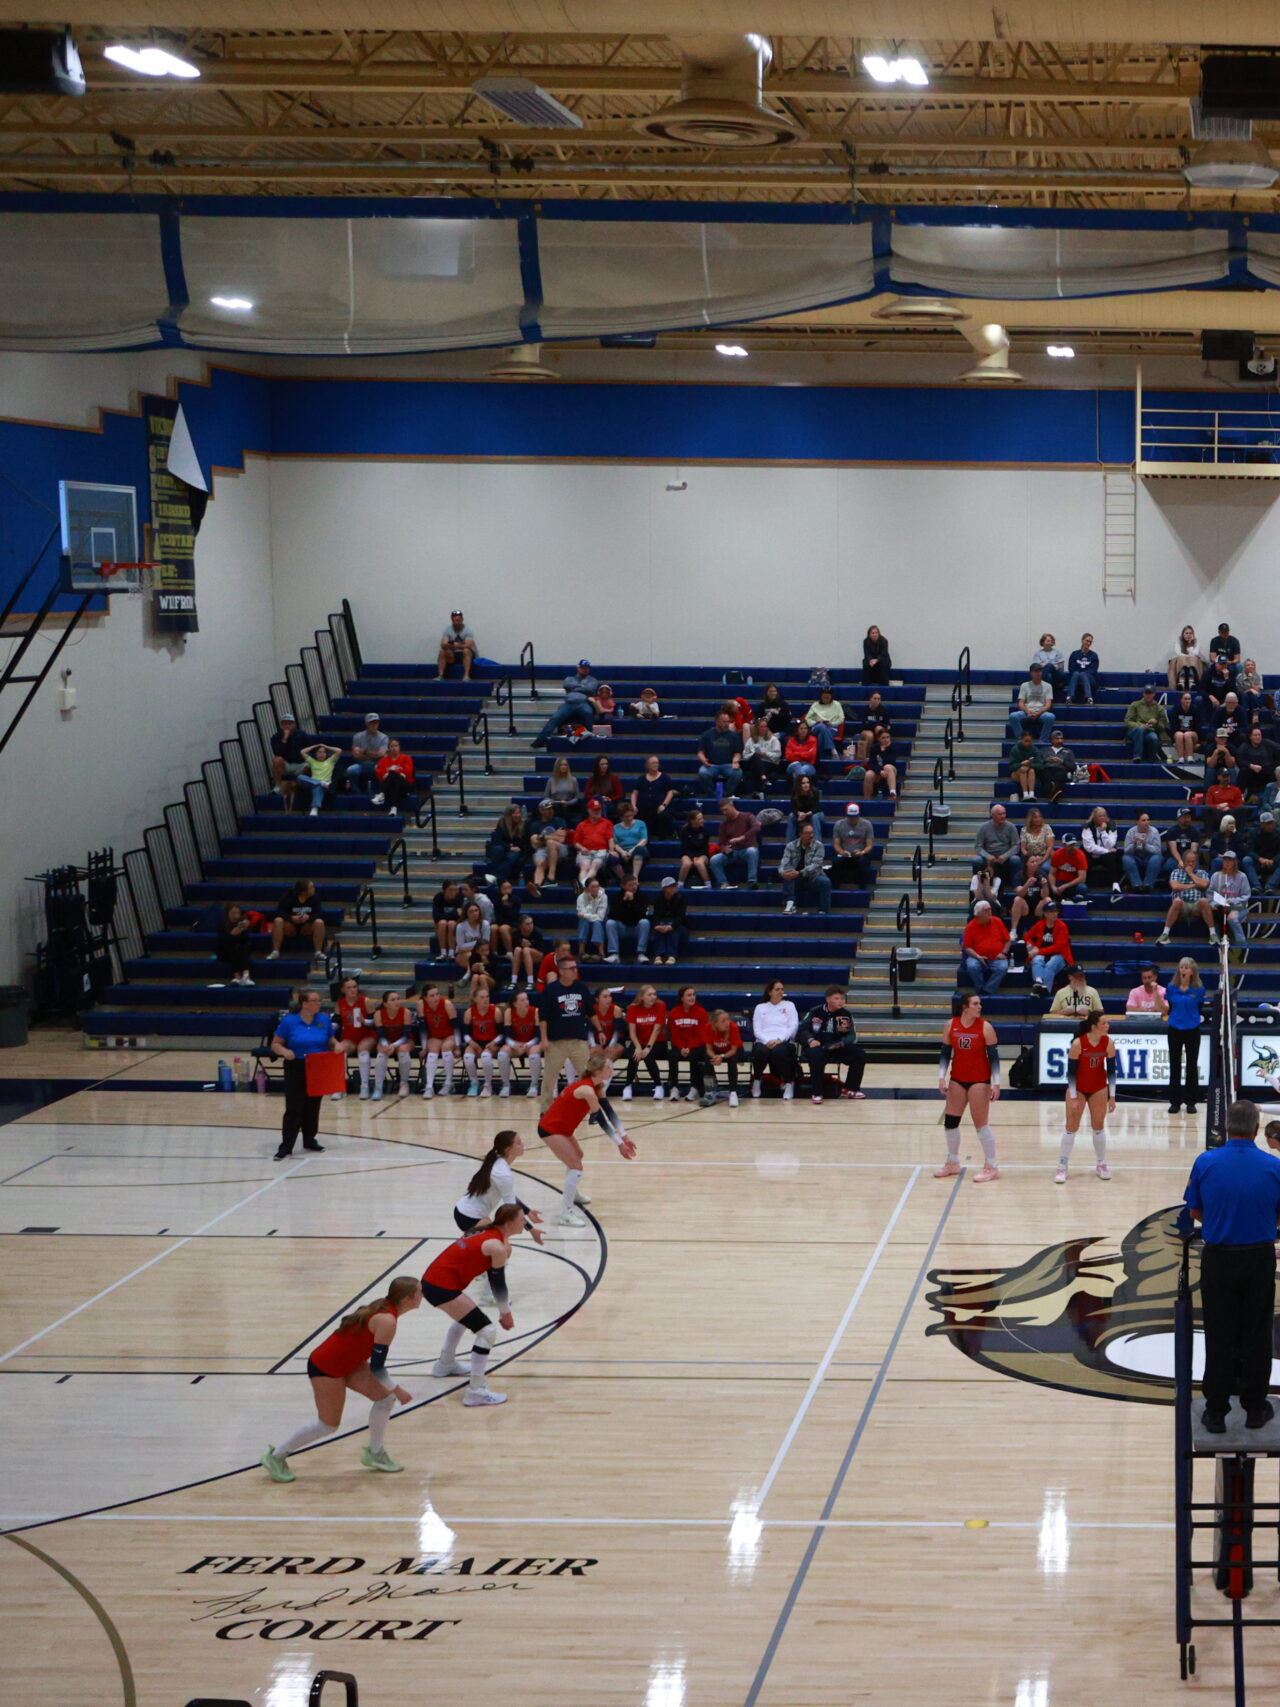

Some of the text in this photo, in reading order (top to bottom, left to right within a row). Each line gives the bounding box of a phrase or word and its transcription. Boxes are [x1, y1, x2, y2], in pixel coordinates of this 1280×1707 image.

[959, 1038, 971, 1049] 12
[177, 1556, 599, 1576] FERD MAIER
[215, 1618, 463, 1641] COURT
